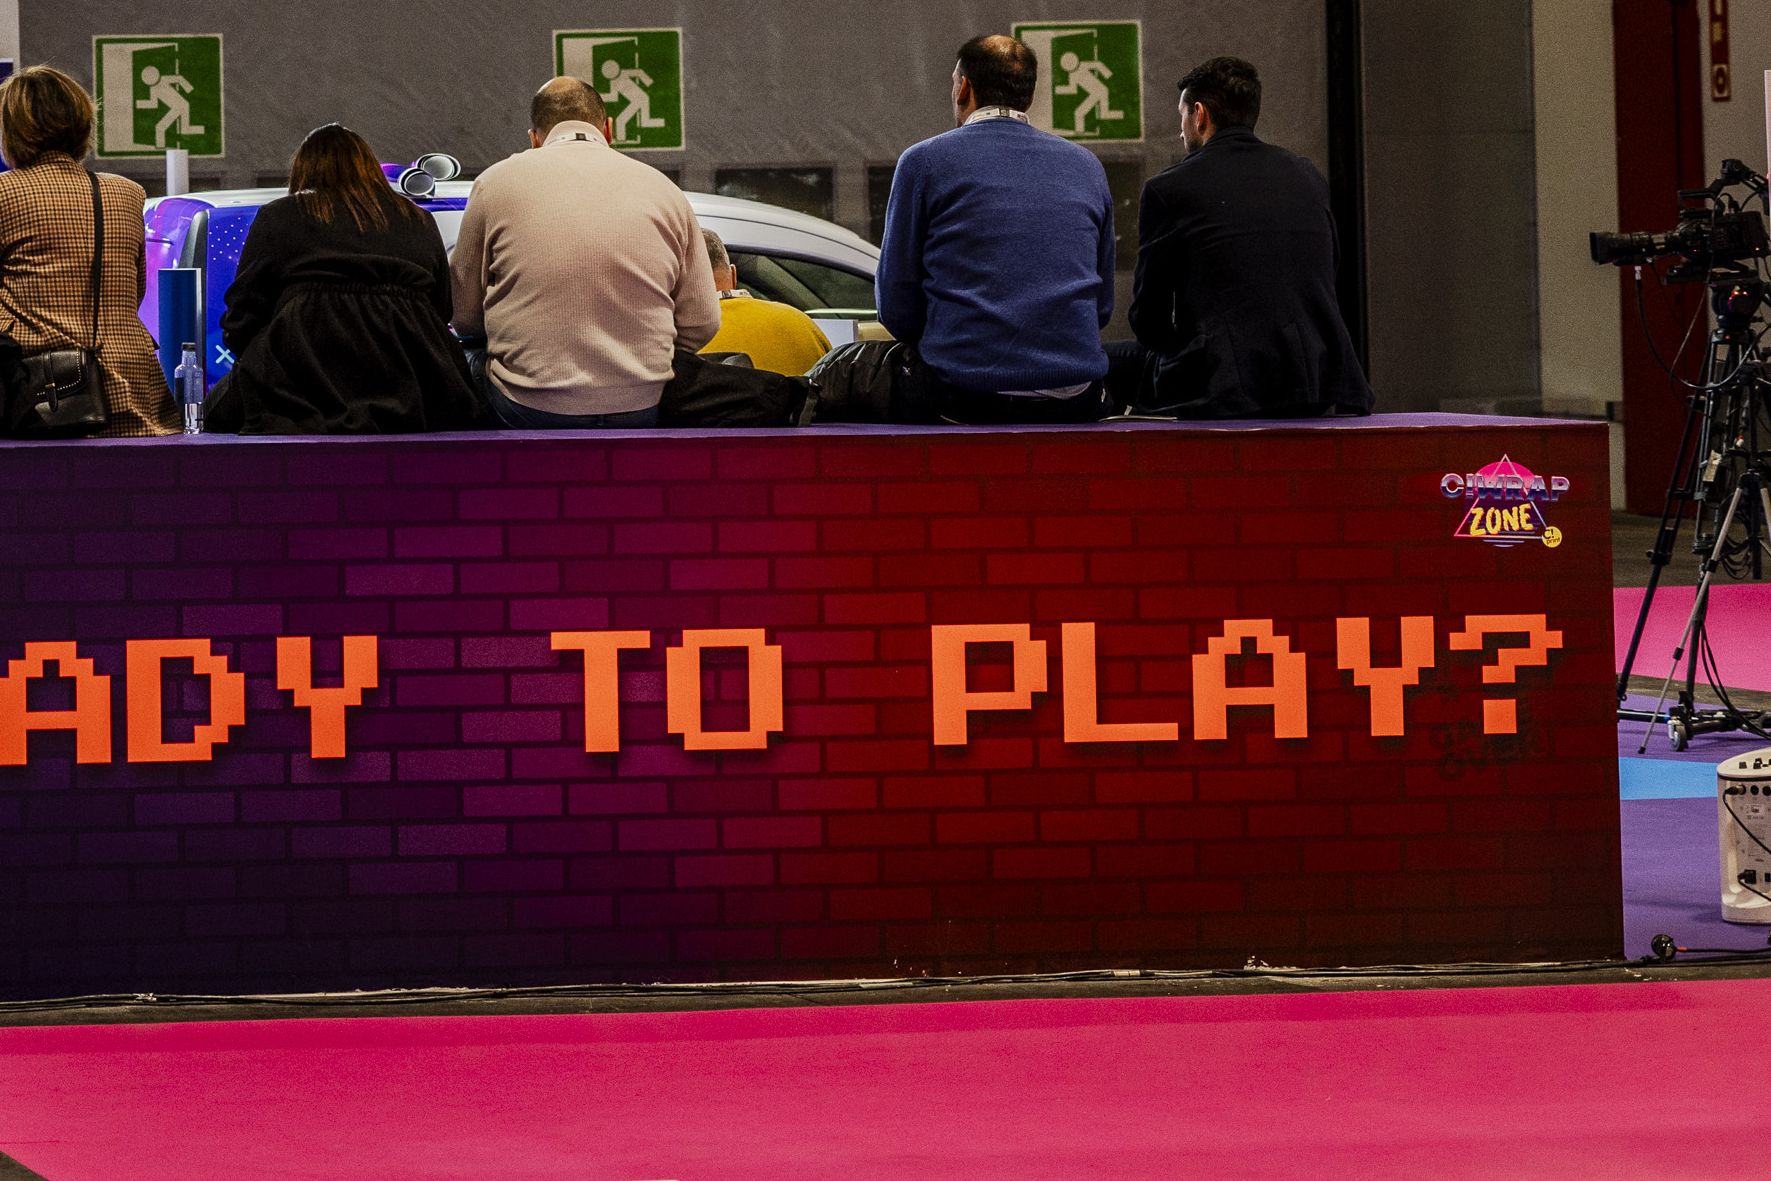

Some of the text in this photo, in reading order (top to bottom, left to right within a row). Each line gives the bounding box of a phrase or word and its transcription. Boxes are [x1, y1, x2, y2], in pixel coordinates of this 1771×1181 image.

[1469, 503, 1534, 536] ZONE
[550, 628, 784, 753] TO
[931, 613, 1564, 746] PLAY?
